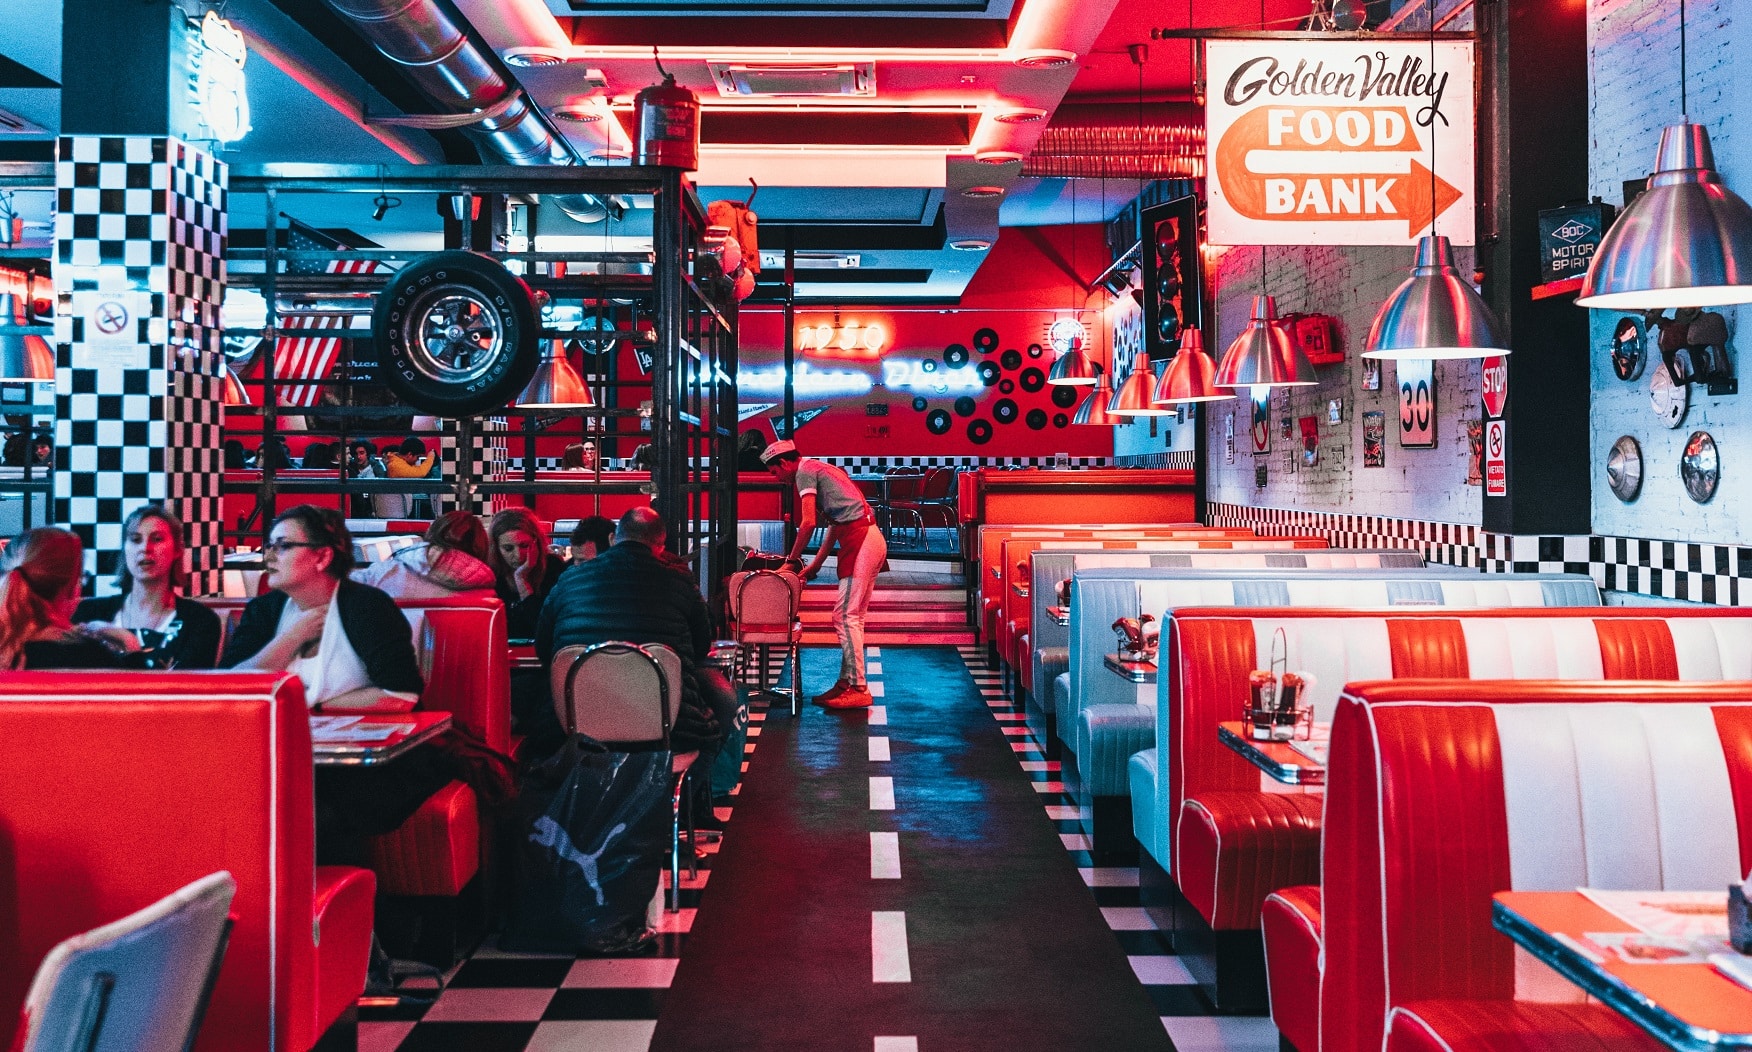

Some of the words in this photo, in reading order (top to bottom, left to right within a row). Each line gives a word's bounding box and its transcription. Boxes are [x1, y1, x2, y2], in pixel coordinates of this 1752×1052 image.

[1223, 56, 1356, 106] Golden
[1355, 51, 1450, 127] Valley
[1268, 109, 1406, 146] FOOD
[1265, 178, 1398, 214] BANK
[1552, 243, 1594, 258] MOTOR
[1552, 256, 1593, 271] SPIRIT
[799, 322, 885, 352] 1950
[686, 362, 871, 387] merican
[884, 361, 983, 387] Diner
[1483, 366, 1506, 393] STOP
[1402, 380, 1429, 432] 30
[1488, 465, 1505, 475] VIETATO
[1488, 479, 1505, 488] FUMARE
